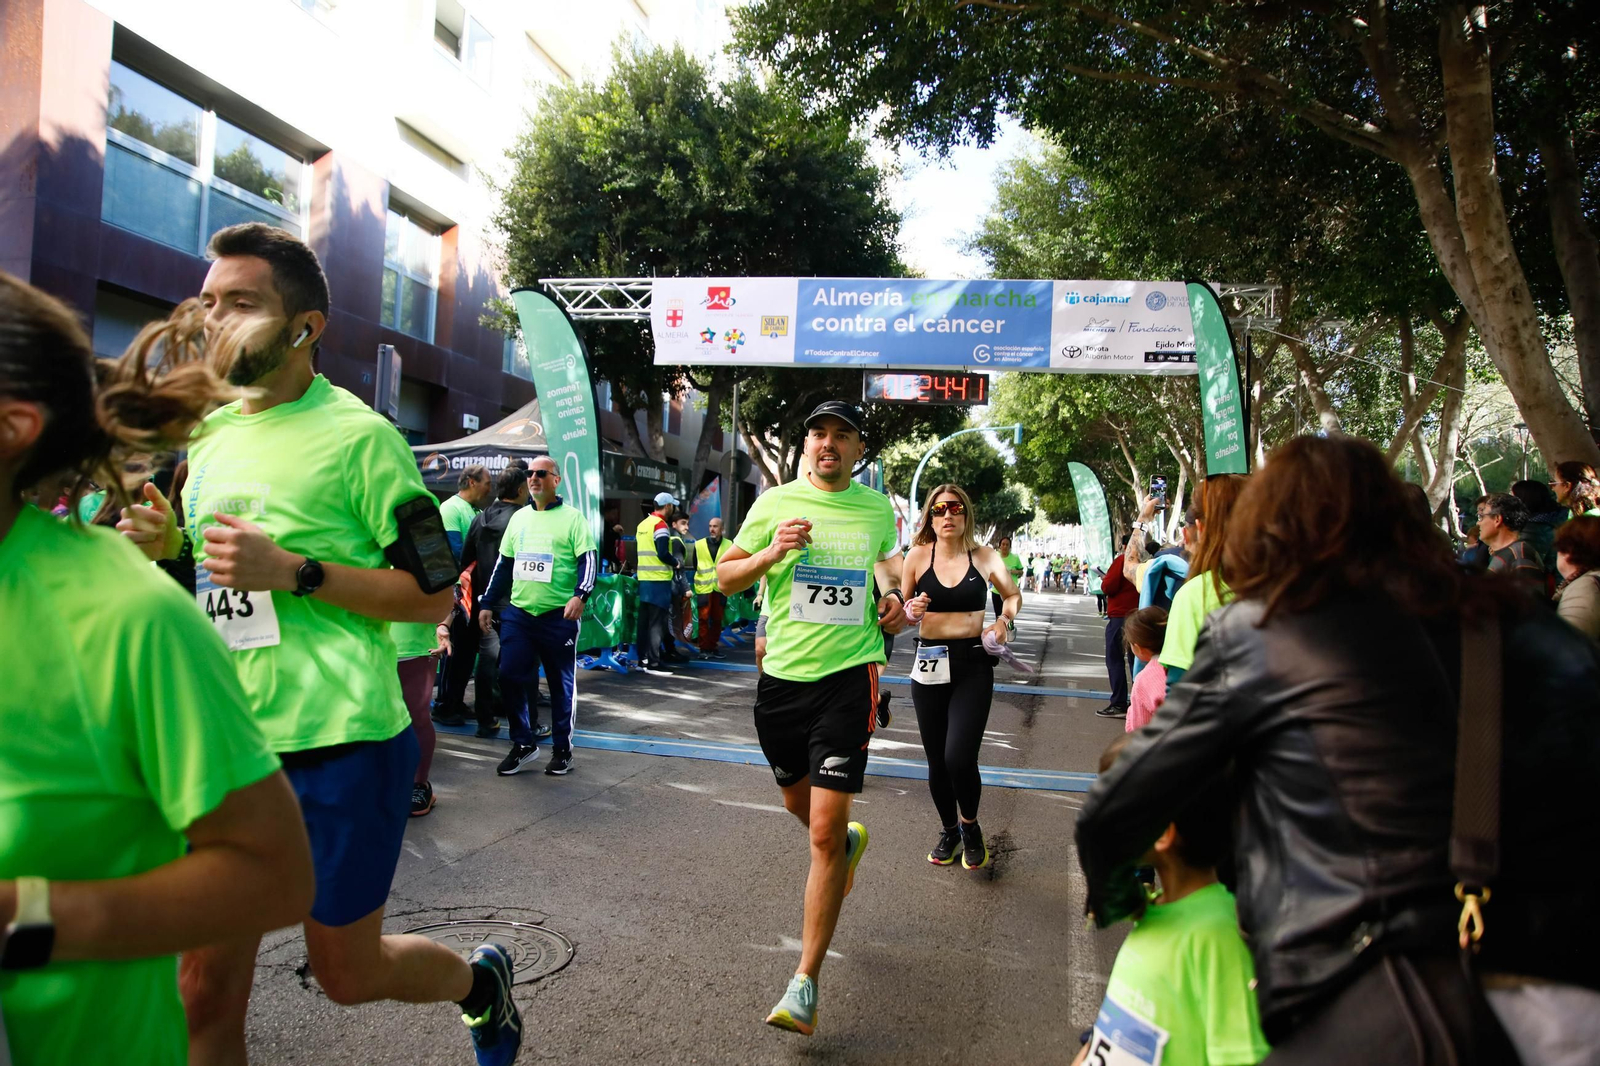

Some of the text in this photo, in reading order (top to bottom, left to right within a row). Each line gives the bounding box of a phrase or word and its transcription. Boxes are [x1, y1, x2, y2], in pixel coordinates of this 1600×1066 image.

[812, 287, 903, 306] Almería
[946, 289, 1037, 308] marcha
[1083, 293, 1131, 306] cajamar
[811, 314, 1006, 334] contra el cáncer
[1127, 321, 1183, 333] Fundación
[1085, 345, 1109, 353] Toyota
[1155, 341, 1175, 349] Ejido
[804, 349, 880, 358] #TodosContraElCáncer
[249, 496, 267, 515] el
[812, 529, 870, 540] En marcha
[812, 540, 870, 552] contra el
[812, 552, 870, 567] cáncer
[522, 561, 545, 572] 196
[806, 584, 854, 607] 733
[205, 590, 254, 623] 443
[828, 770, 849, 778] BLACKS
